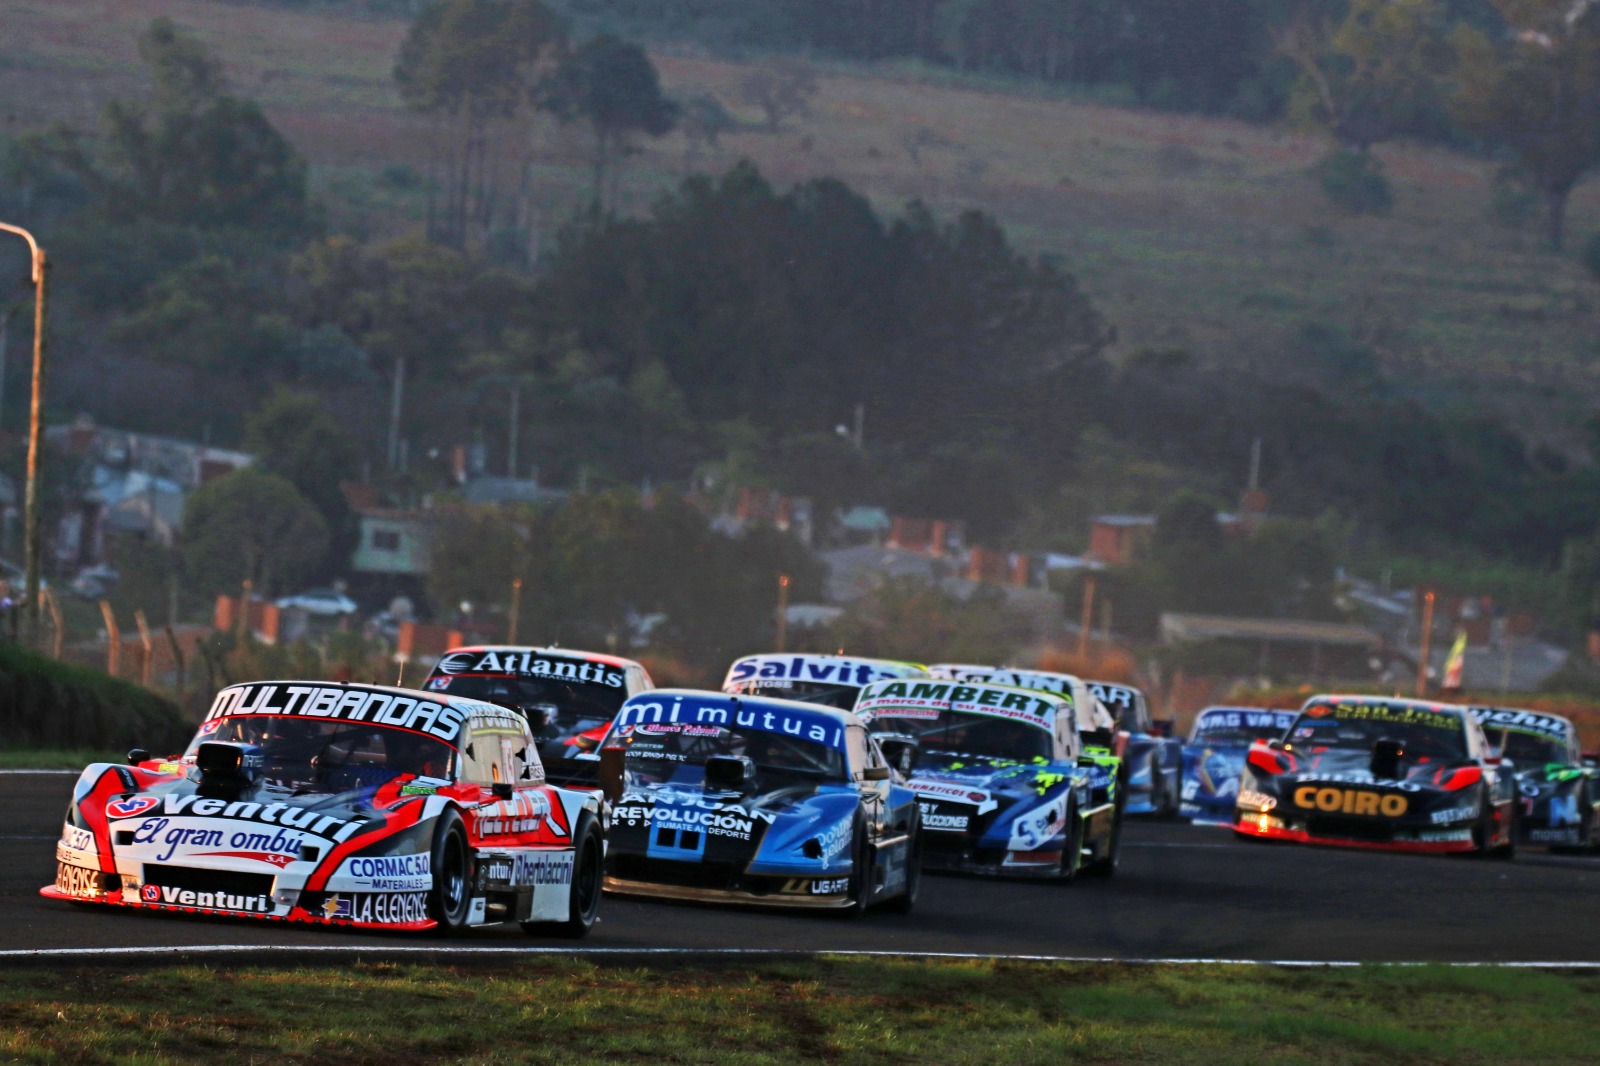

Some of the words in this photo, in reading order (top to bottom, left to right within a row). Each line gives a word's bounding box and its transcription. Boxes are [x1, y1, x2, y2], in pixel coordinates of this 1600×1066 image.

[472, 652, 623, 688] Atlantis
[206, 686, 464, 741] MULTIBANDAS
[860, 681, 1052, 717] LAMBERT
[876, 698, 926, 707] marca
[931, 699, 951, 707] de
[956, 702, 976, 710] su
[980, 705, 1052, 729] acoplado
[619, 696, 684, 726] mi
[697, 707, 842, 748] mutual
[619, 794, 674, 805] AN
[680, 799, 777, 825] JUAN
[1293, 786, 1409, 817] COIRO
[163, 793, 369, 844] Venturi
[612, 806, 753, 833] REVOLUCIÓN
[656, 821, 693, 832] SUMATE
[694, 826, 706, 834] AL
[708, 827, 751, 841] DEPORTE
[133, 818, 169, 844] El
[156, 823, 223, 862] gran
[230, 828, 305, 855] ombú
[265, 854, 287, 865] S.A.
[349, 857, 413, 878] CORMAC
[415, 855, 429, 876] 5.0
[489, 861, 512, 880] nturi
[161, 885, 267, 912] Venturi
[371, 879, 424, 890] MATERIALES
[811, 878, 849, 894] UGARTE
[353, 893, 373, 923] LA
